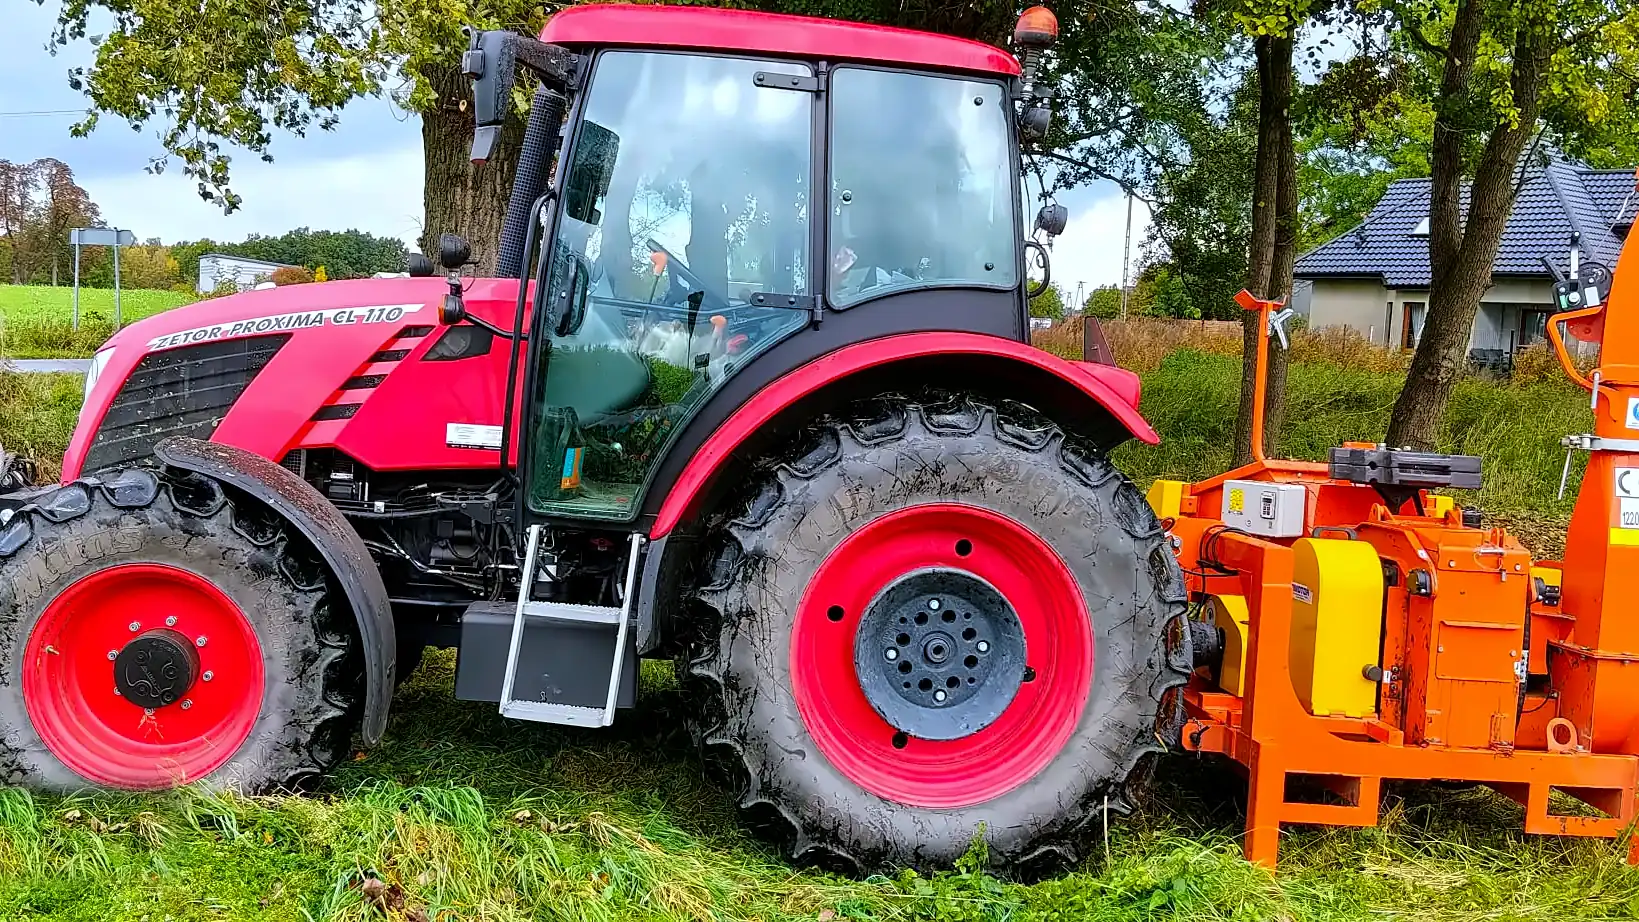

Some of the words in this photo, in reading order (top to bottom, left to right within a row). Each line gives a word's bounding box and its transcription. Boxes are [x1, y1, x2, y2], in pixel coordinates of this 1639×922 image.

[155, 327, 222, 349] ZETOR
[229, 311, 325, 336] PROXIMA
[332, 310, 356, 324] CL
[363, 307, 404, 322] 110
